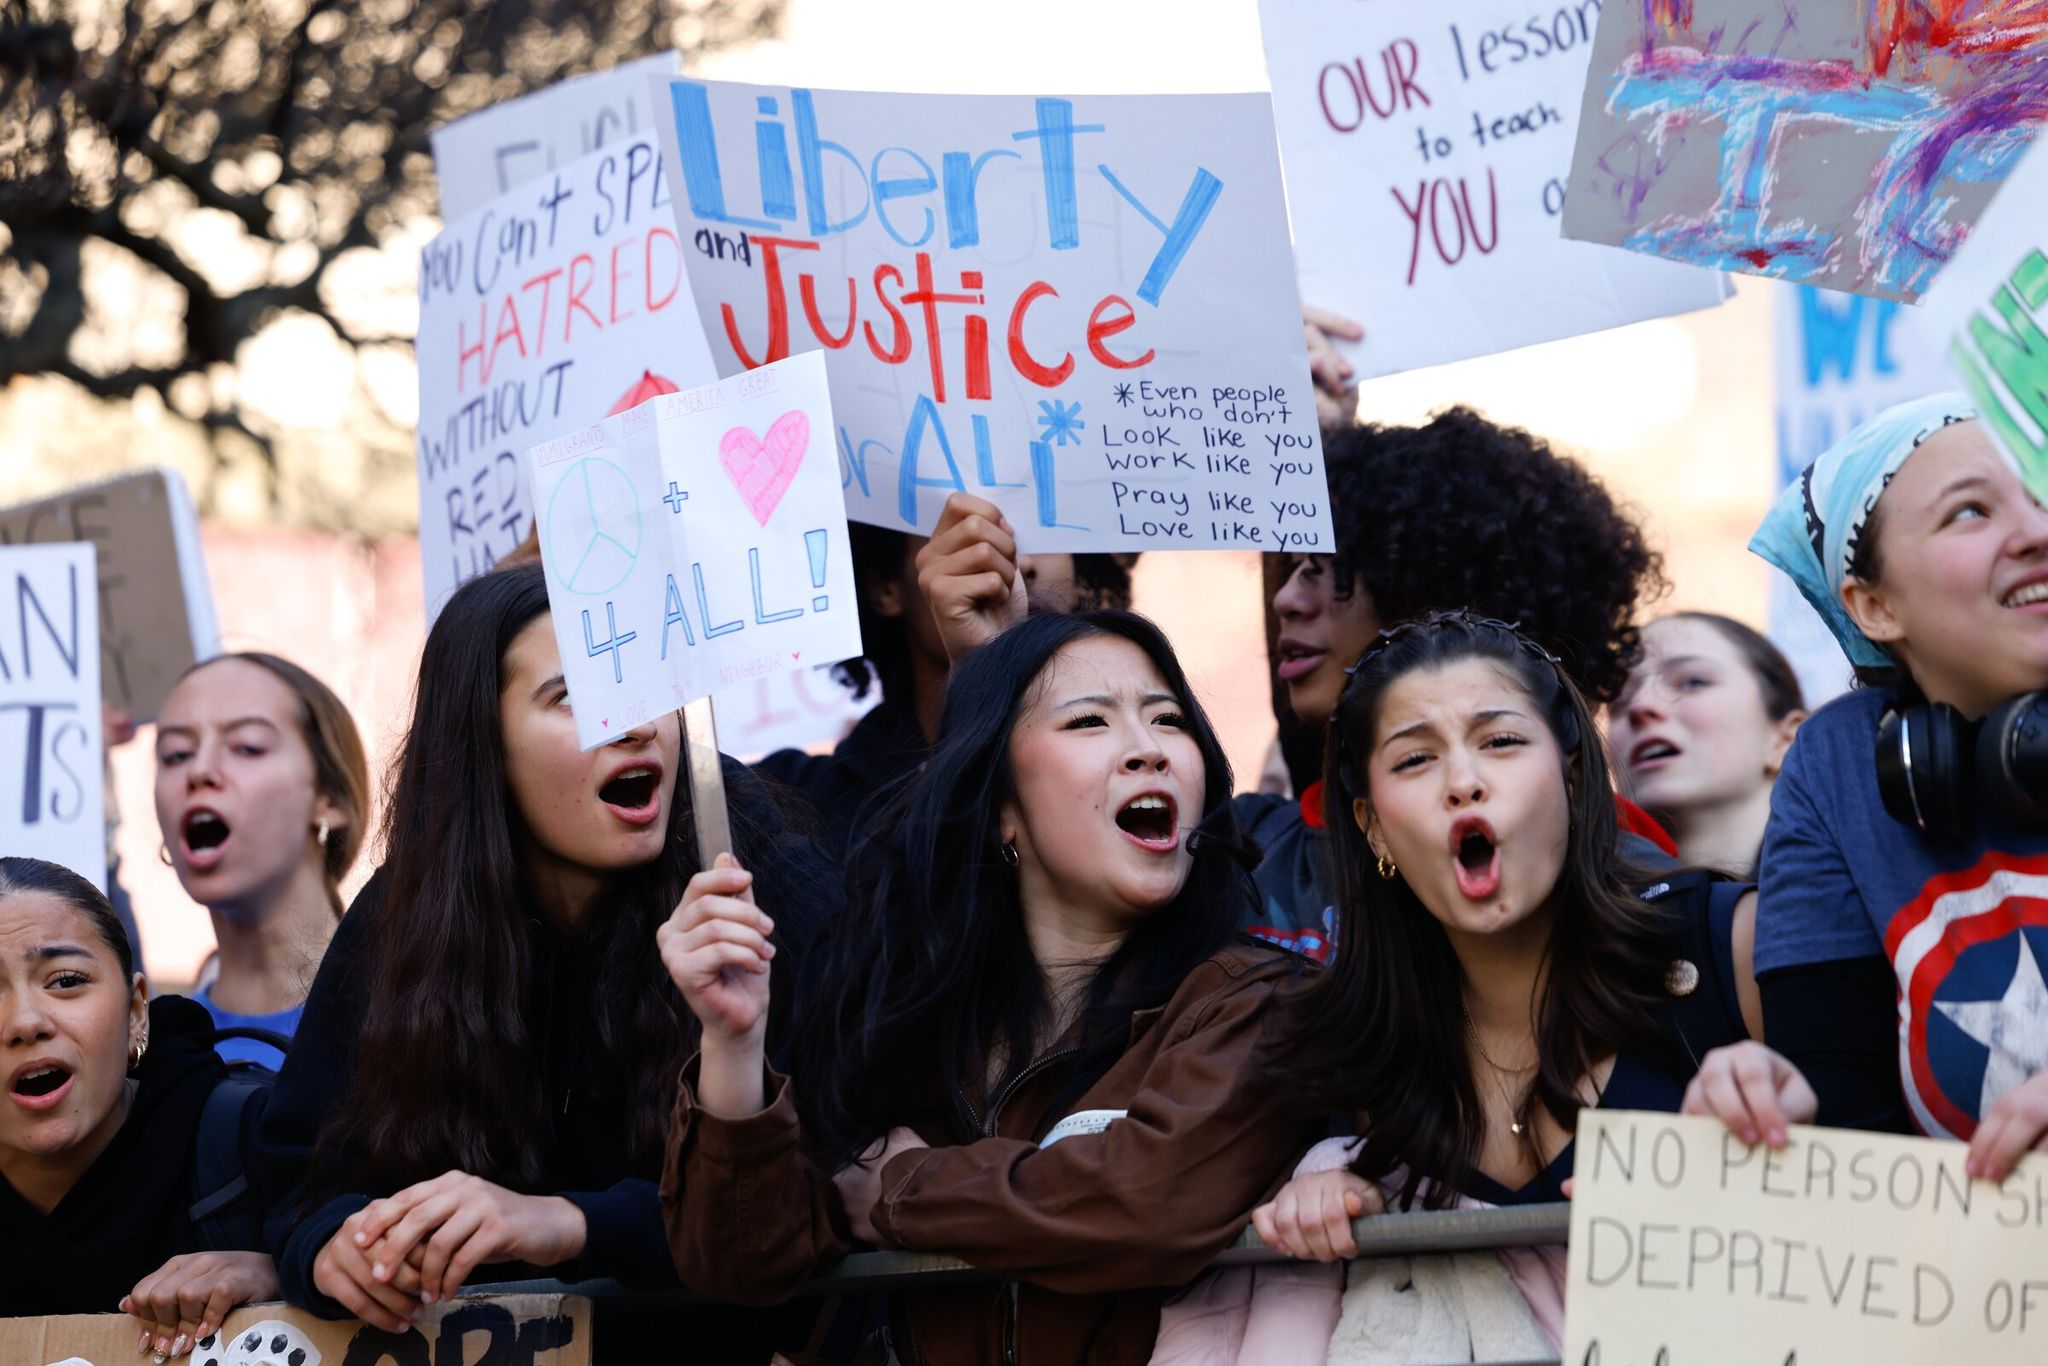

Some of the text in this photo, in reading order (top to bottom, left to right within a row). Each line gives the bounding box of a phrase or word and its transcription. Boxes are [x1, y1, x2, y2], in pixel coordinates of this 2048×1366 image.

[1319, 37, 1431, 133] OUR
[1418, 101, 1561, 163] to teach
[669, 81, 1224, 308] Liberty
[1391, 167, 1498, 286] YOU
[694, 228, 752, 267] and
[455, 226, 682, 392] HATRED
[720, 235, 1156, 403] Justice
[421, 358, 574, 481] WITHOUT
[665, 387, 726, 416] AMERICA
[738, 368, 777, 398] GREAT
[1143, 402, 1293, 424] who don't
[1212, 384, 1288, 411] people
[1103, 424, 1313, 456] Look like you
[1206, 454, 1251, 475] like
[1269, 462, 1313, 486] you
[446, 452, 516, 545] RED
[1112, 481, 1317, 524] Pray like you
[1119, 513, 1319, 552] Love like you
[0, 562, 79, 680] N
[581, 529, 829, 683] 4 ALL!
[1591, 1124, 1686, 1189] NO
[1719, 1128, 1974, 1218] PERSON
[1585, 1215, 2048, 1334] DEPRIVED OF
